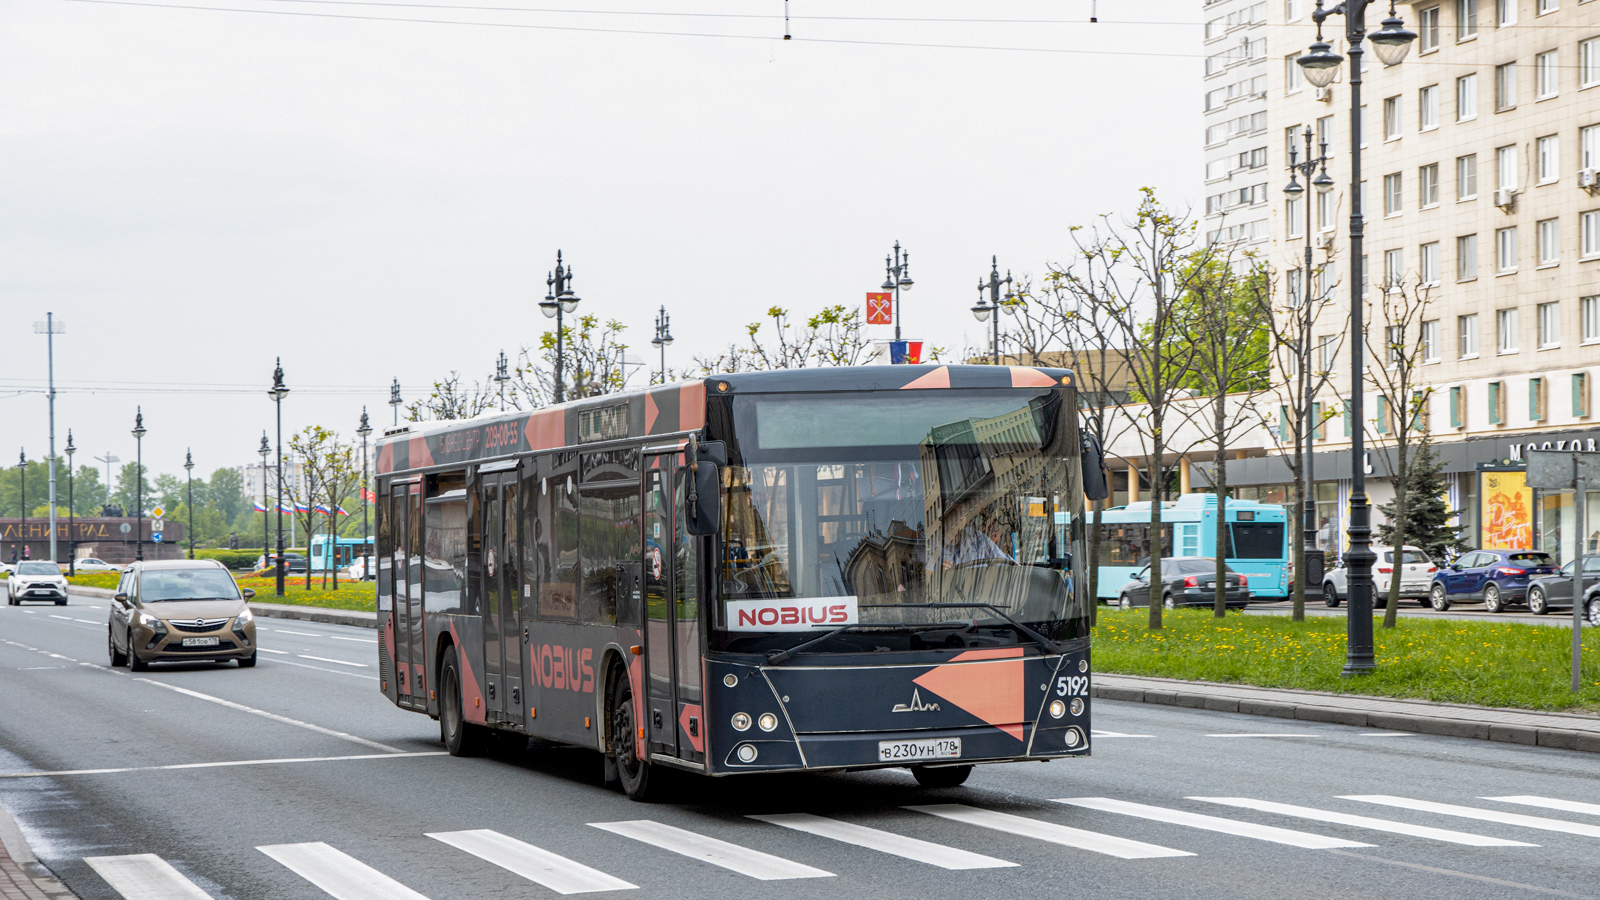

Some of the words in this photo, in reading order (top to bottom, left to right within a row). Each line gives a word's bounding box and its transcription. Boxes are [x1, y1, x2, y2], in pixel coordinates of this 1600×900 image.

[486, 421, 518, 448] 209-00-55
[738, 604, 848, 627] NOBIUS
[530, 643, 595, 693] NOBIUS
[1056, 675, 1089, 697] 5192
[884, 743, 935, 759] В230УН
[936, 740, 956, 752] 178
